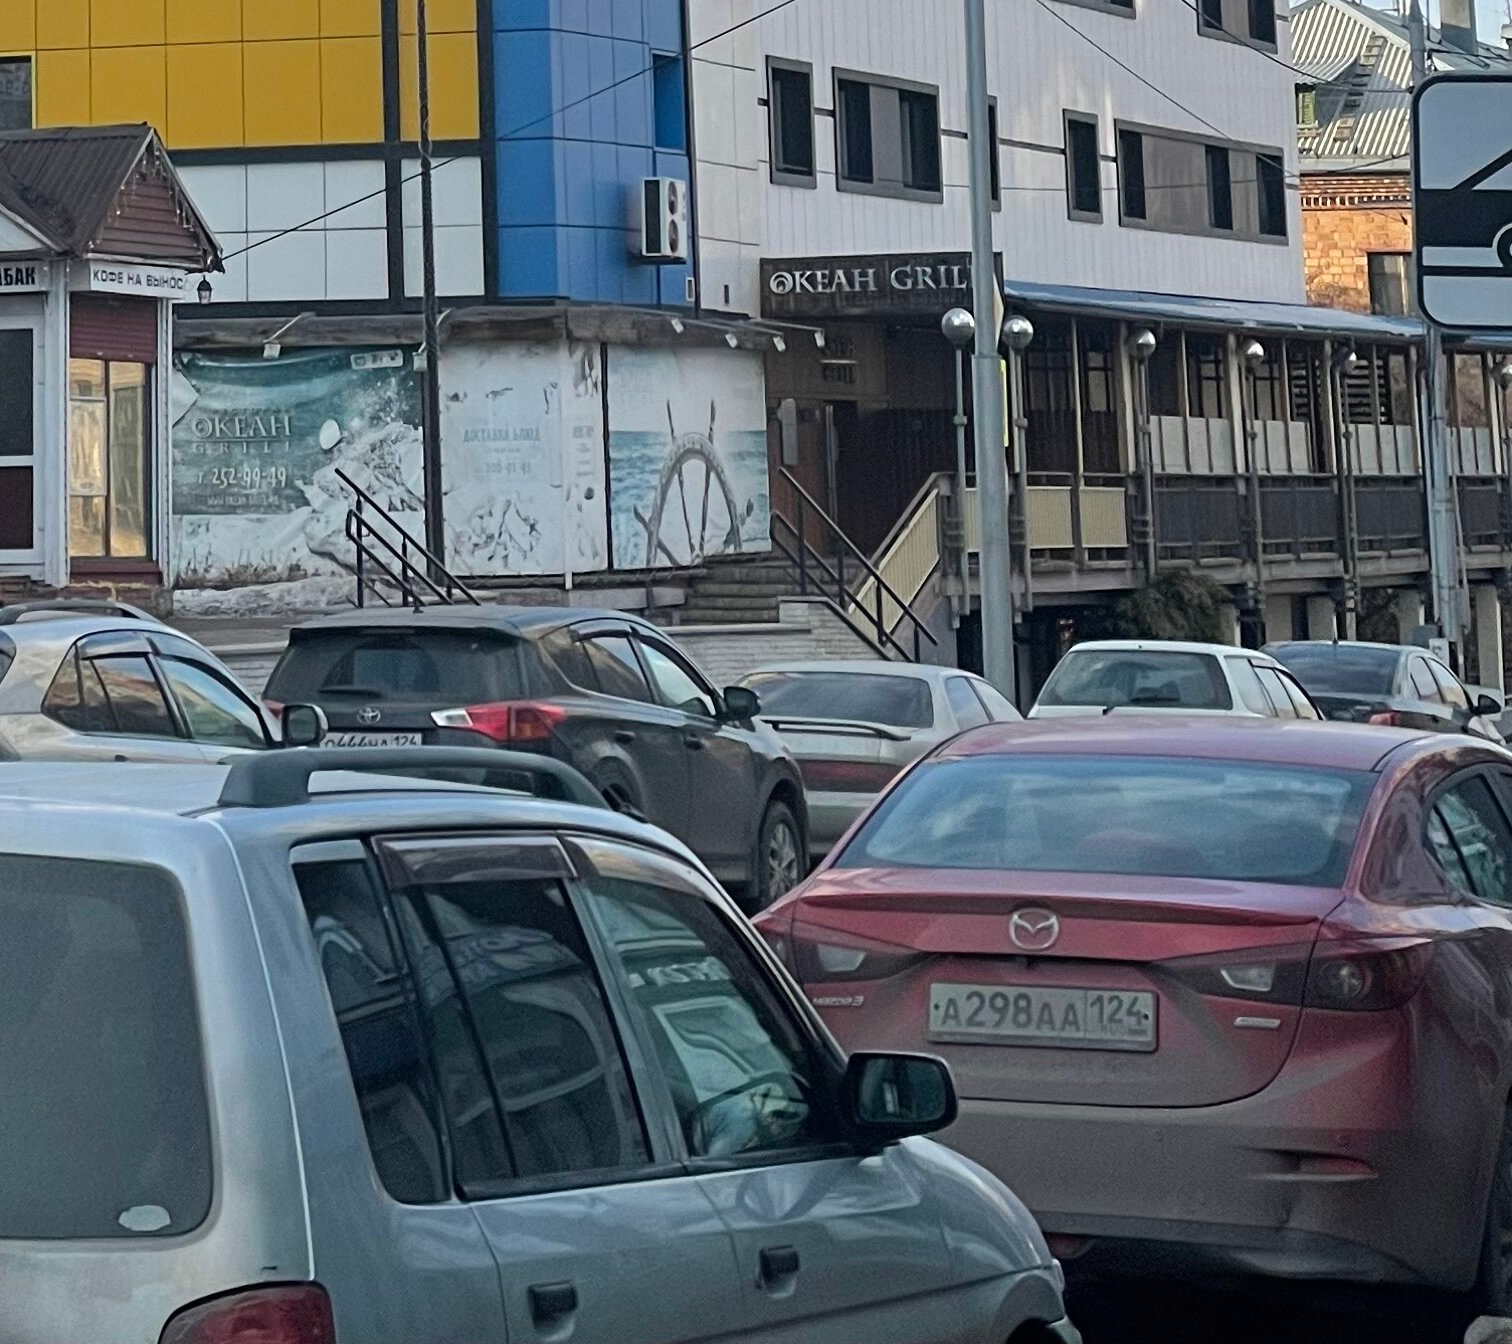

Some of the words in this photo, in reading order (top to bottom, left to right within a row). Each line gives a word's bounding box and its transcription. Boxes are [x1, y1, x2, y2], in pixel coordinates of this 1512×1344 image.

[93, 269, 124, 285] КОФЕ
[127, 273, 142, 286] НА
[146, 274, 184, 290] ВЫНОС
[890, 264, 974, 291] GRIL
